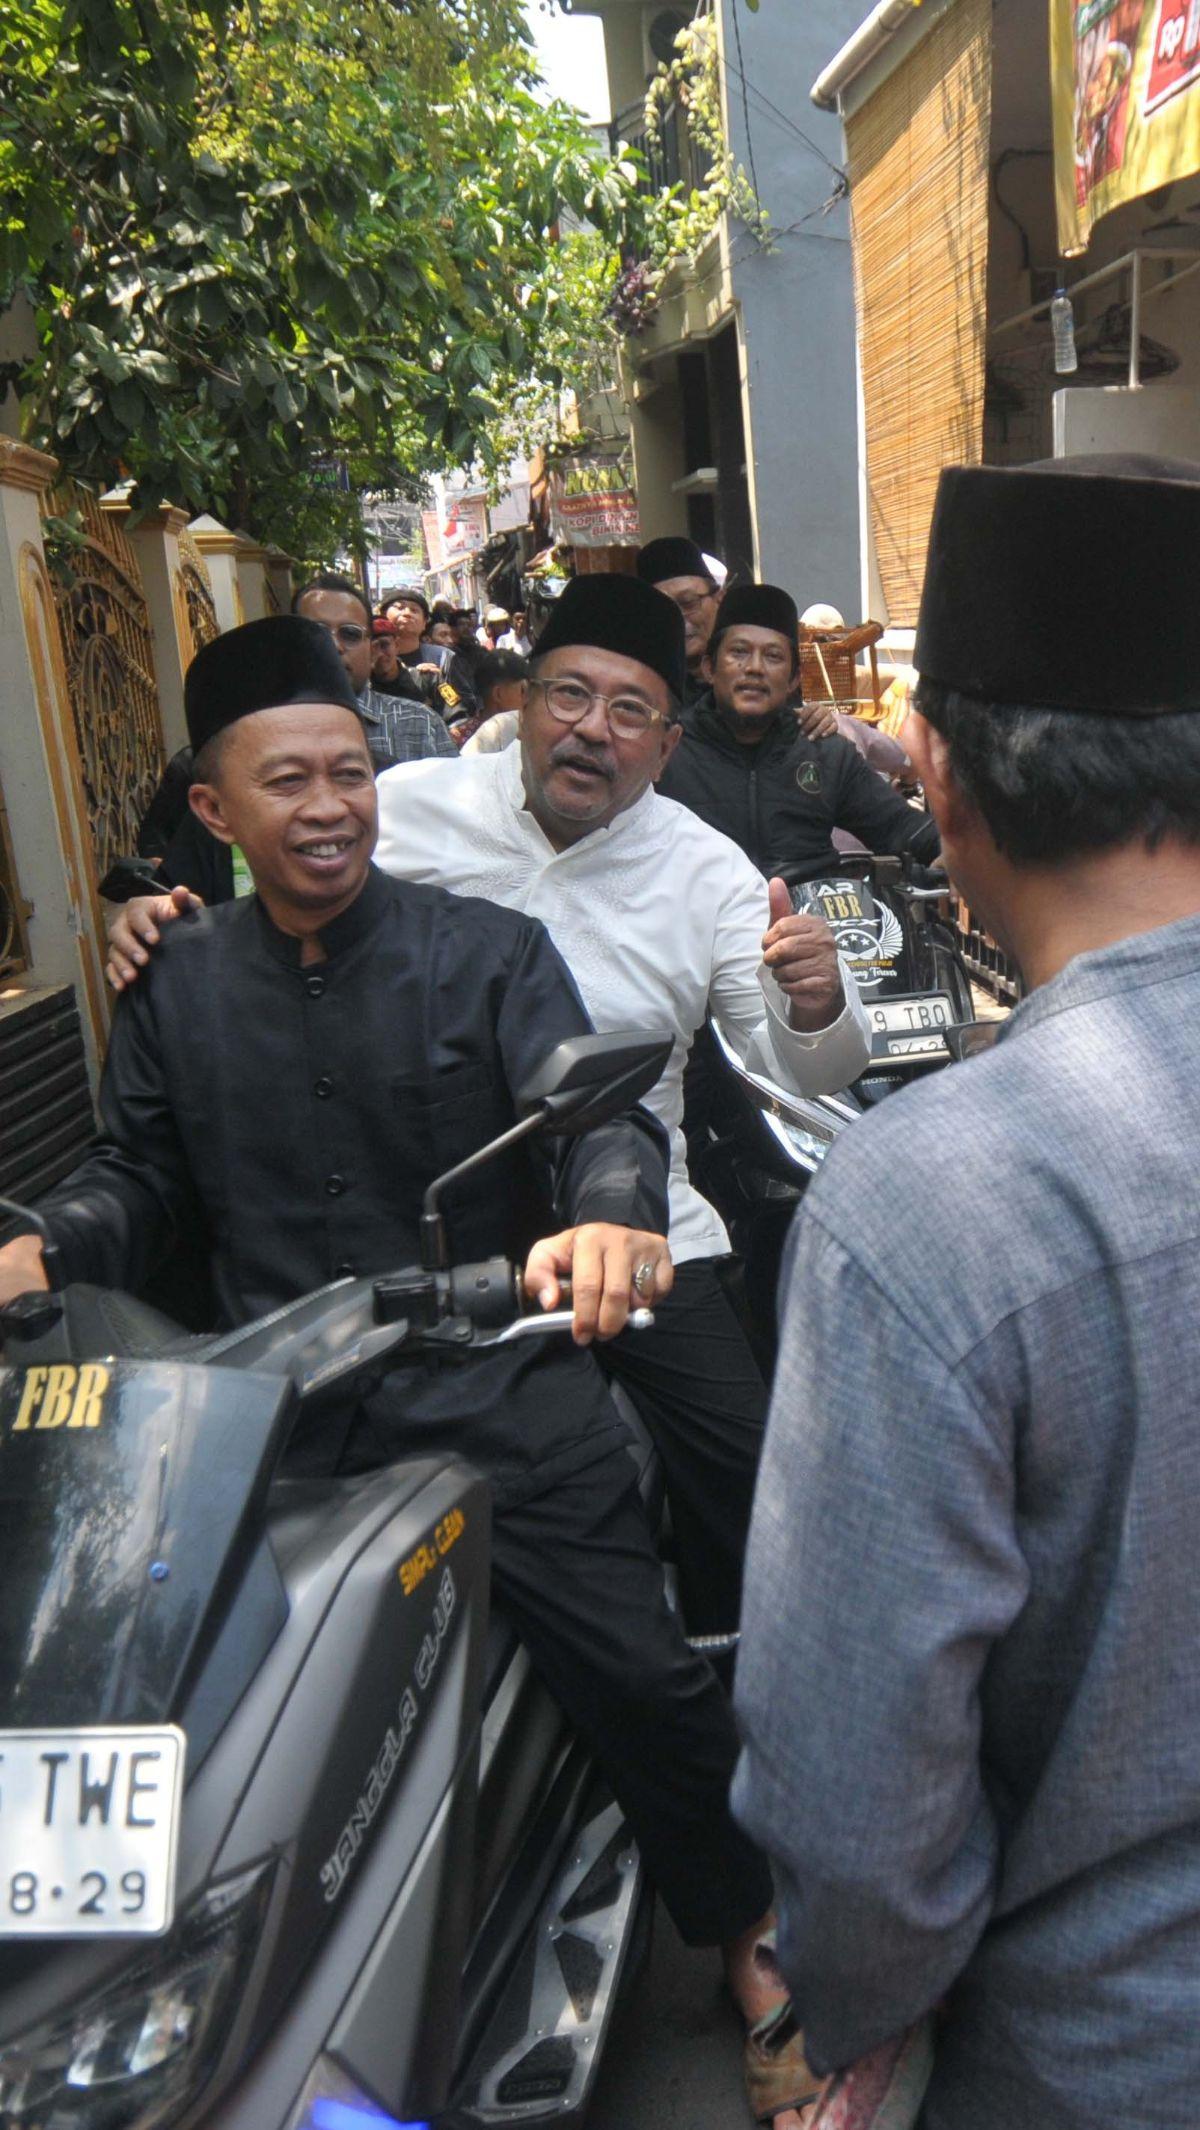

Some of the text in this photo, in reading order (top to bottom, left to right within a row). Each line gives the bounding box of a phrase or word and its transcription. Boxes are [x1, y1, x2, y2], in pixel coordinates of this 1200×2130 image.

[823, 894, 863, 919] FBR
[861, 1075, 904, 1086] HONDA
[12, 1363, 110, 1431] FBR
[414, 1565, 457, 1690] CLUB
[40, 1751, 161, 1827] TWE
